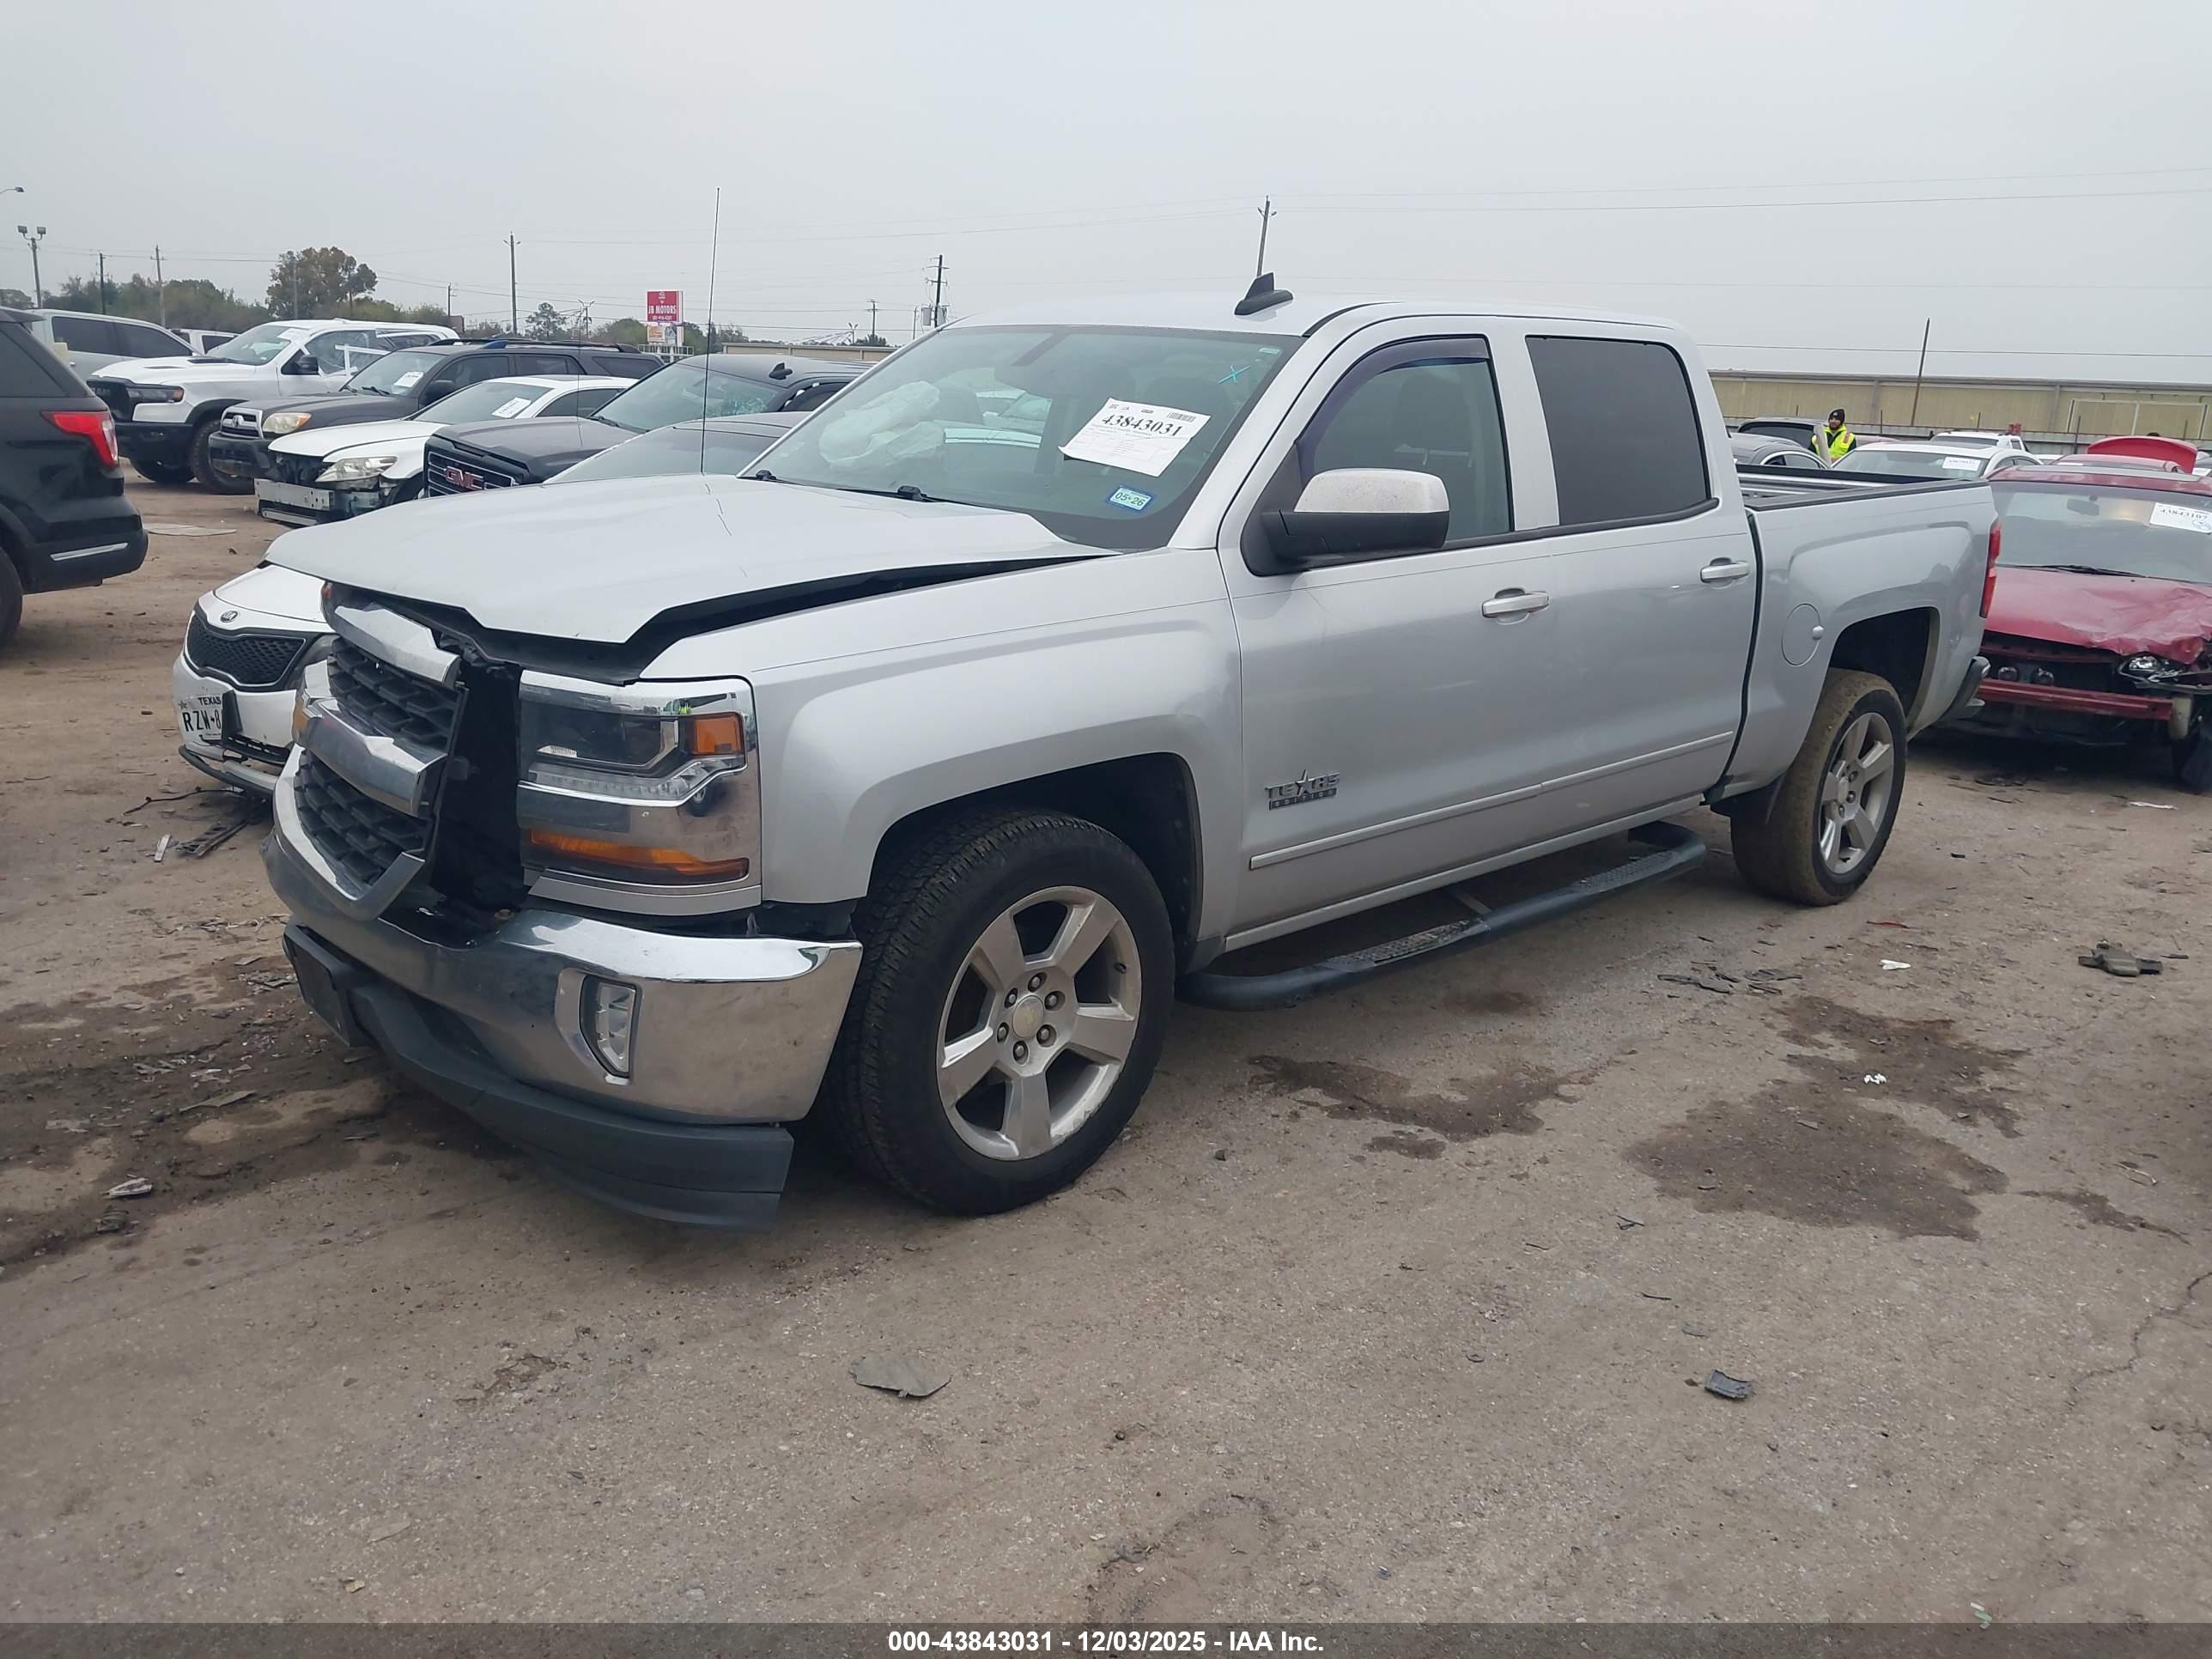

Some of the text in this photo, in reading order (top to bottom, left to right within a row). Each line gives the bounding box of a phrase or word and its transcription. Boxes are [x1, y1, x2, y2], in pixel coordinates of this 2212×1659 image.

[655, 305, 677, 314] MOTORS
[1102, 414, 1183, 437] 43843031
[446, 465, 483, 490] GMC
[198, 696, 222, 706] TEXAS
